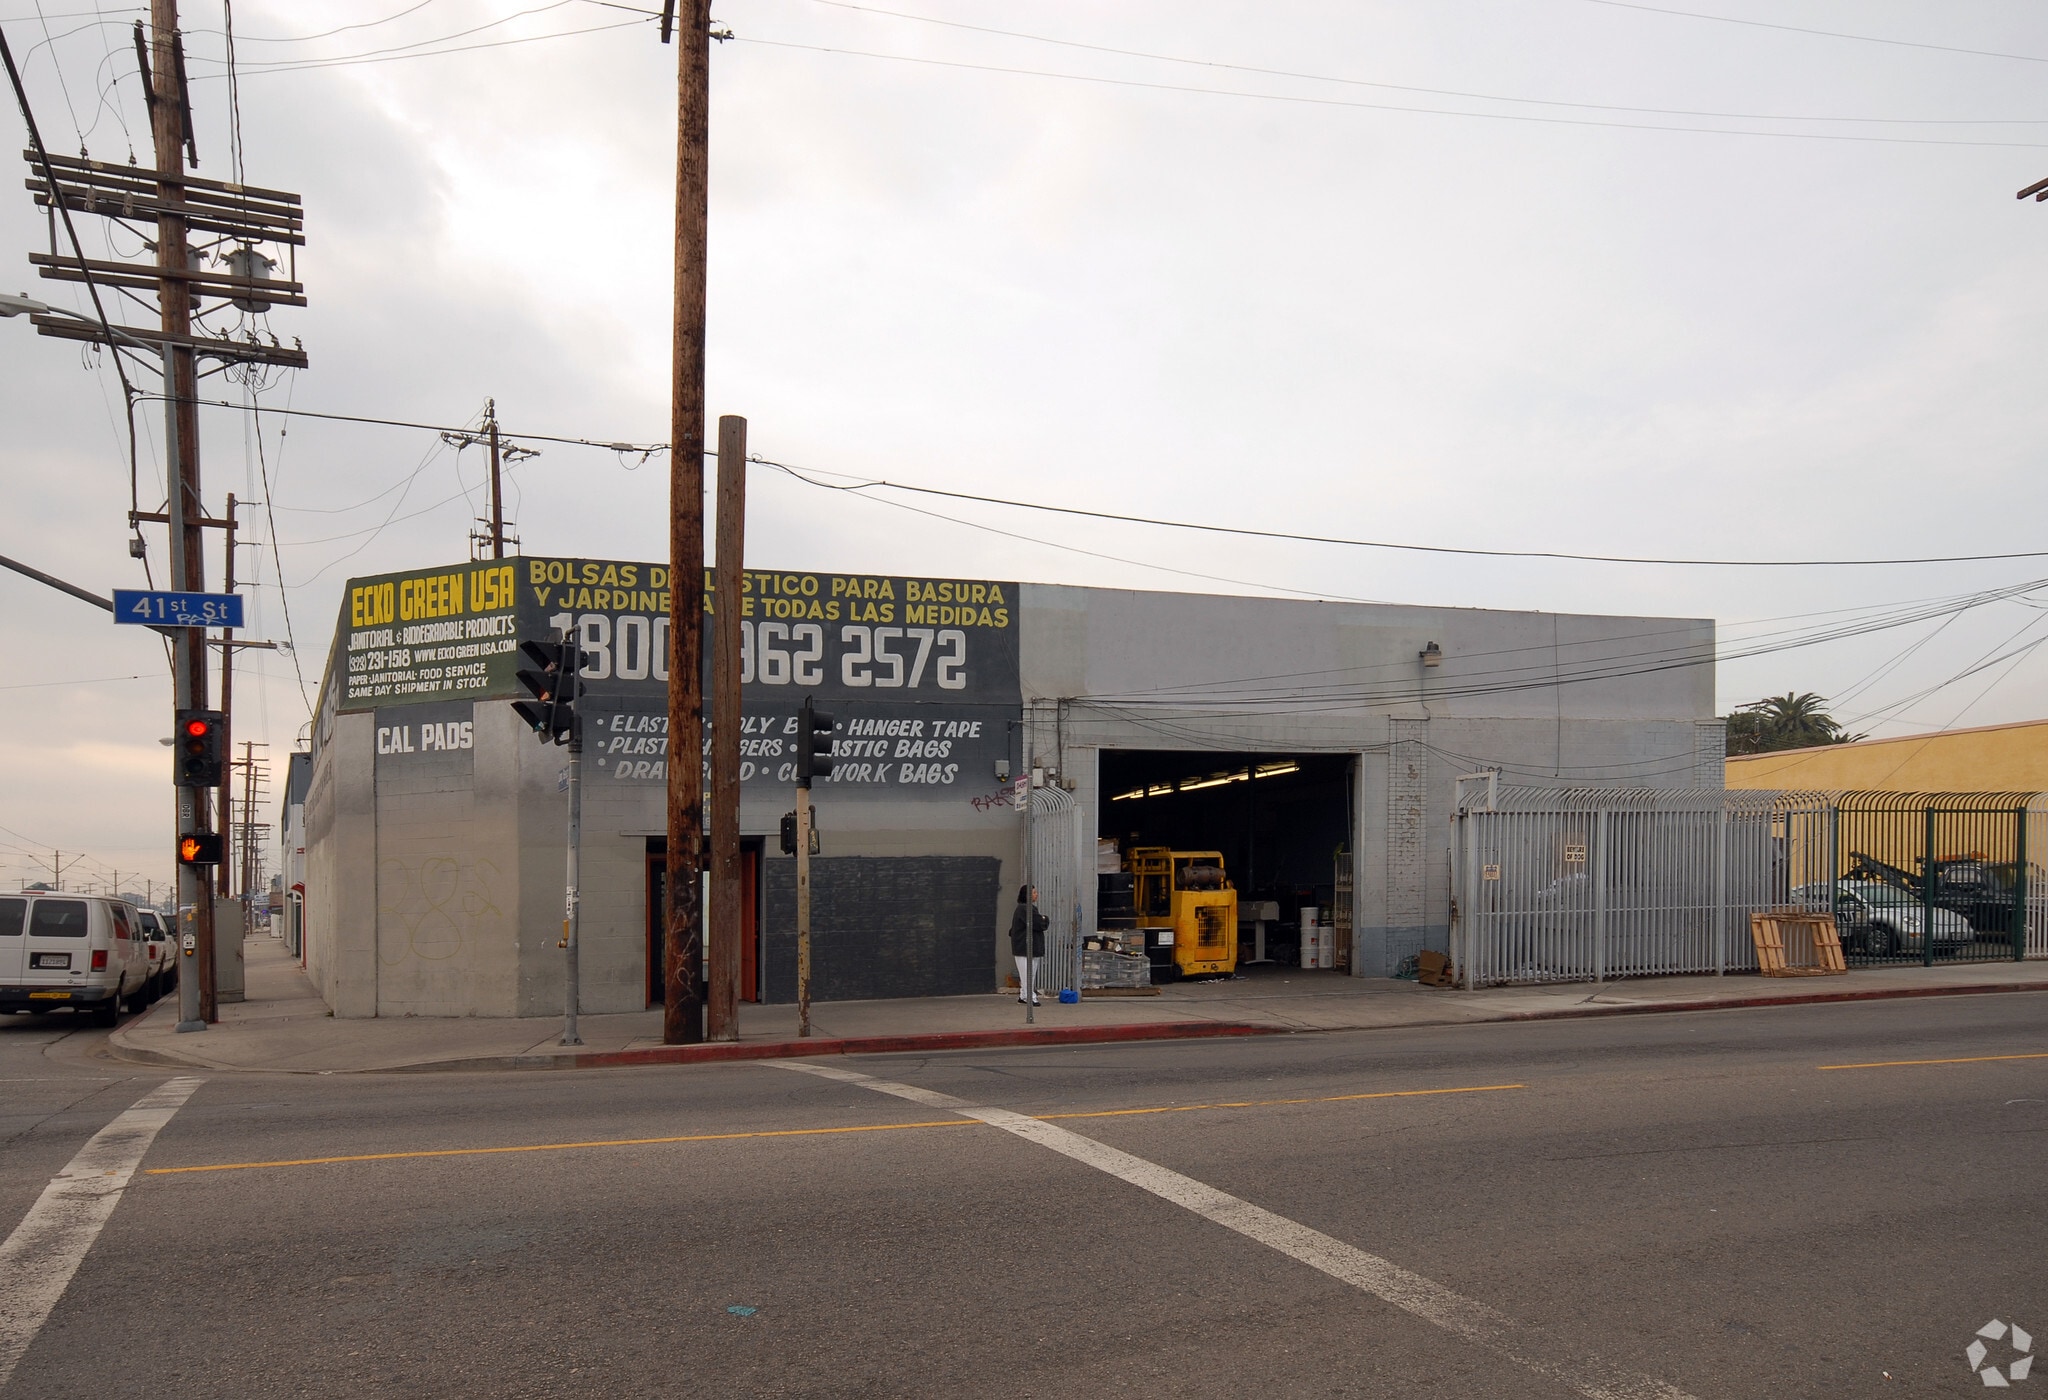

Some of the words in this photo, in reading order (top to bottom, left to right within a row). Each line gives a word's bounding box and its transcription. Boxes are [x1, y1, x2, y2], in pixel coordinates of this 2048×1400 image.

[530, 560, 638, 588] BOLSAS
[650, 568, 671, 589] D
[831, 578, 895, 600] PARA
[906, 581, 1005, 604] BASURA
[132, 597, 187, 619] 41st
[202, 601, 228, 619] St
[352, 582, 394, 627] ECKO
[400, 573, 463, 621] GREEN
[470, 566, 514, 612] USA
[533, 586, 551, 607] Y
[761, 598, 840, 621] TODAS
[850, 601, 895, 622] LAS
[906, 604, 1009, 628] MEDIDAS
[347, 629, 395, 651] JANITORIAL
[396, 631, 402, 644] &
[403, 621, 463, 645] BIODEGRADABLE
[465, 615, 515, 639] PRODUCTS
[349, 653, 366, 672] (323)
[367, 649, 410, 670] 231-1518
[841, 625, 966, 690] 2572
[349, 674, 368, 686] PAPER
[420, 668, 442, 680] FOOD
[445, 663, 486, 678] SERVICE
[348, 686, 373, 698] SAME
[374, 684, 392, 696] DAY
[394, 680, 441, 694] SHIPMENT
[443, 680, 453, 690] IN
[456, 676, 488, 689] STOCK
[377, 726, 415, 755] CAL
[421, 721, 473, 751] PADS
[847, 719, 924, 737] HANGER
[932, 720, 982, 738] TAPE
[894, 740, 952, 758] BAGS
[898, 763, 959, 785] BAGS
